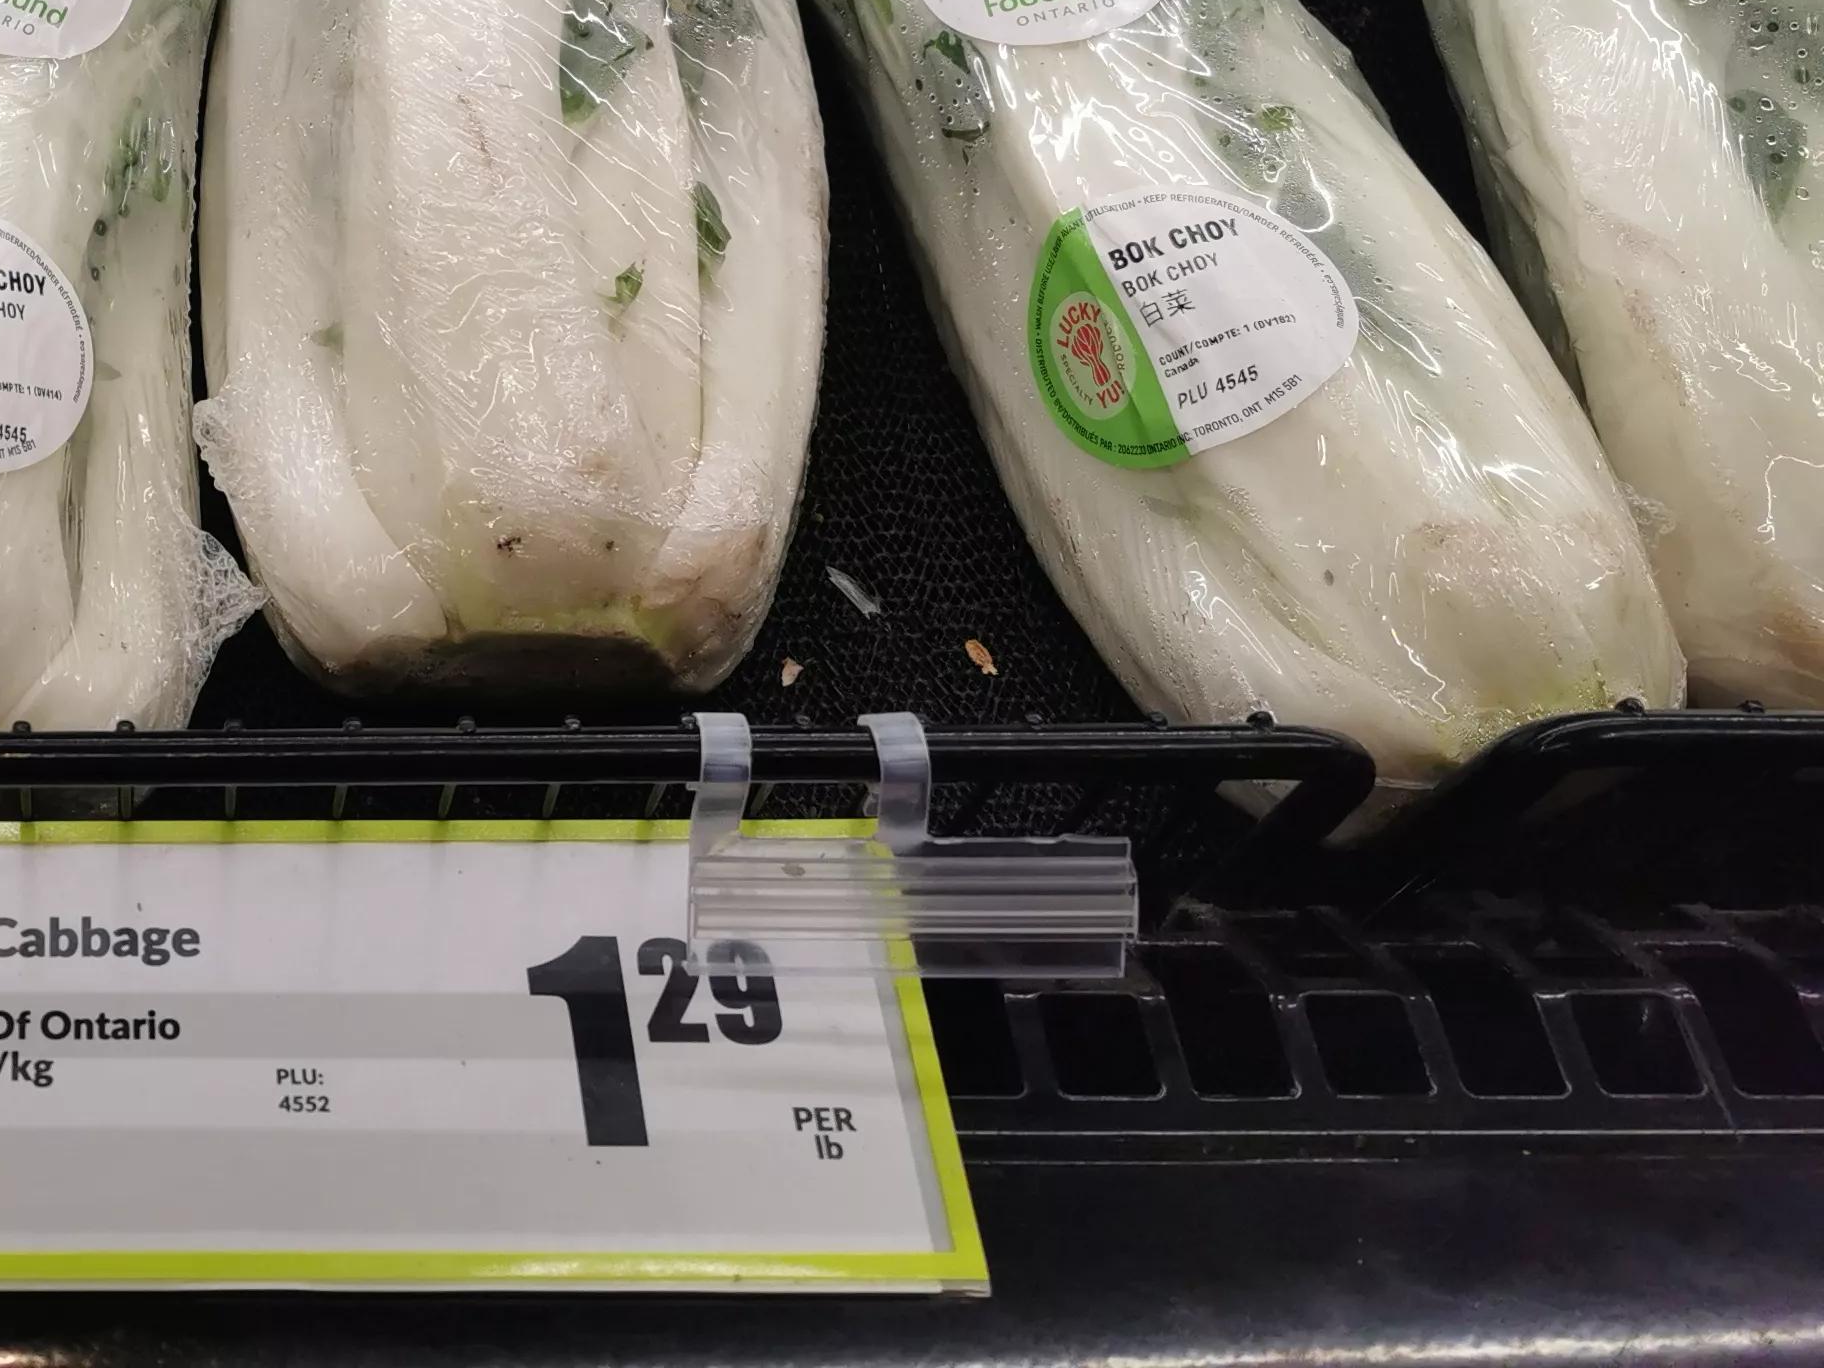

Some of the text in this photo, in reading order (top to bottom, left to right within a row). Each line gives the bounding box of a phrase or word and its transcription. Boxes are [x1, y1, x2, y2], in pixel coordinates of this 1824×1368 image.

[1143, 193, 1167, 205] KEEP
[1108, 217, 1239, 271] BOK CHOY
[1122, 252, 1219, 298] BOK CHOY
[1140, 288, 1196, 327] 白菜
[1057, 301, 1102, 349] LUCKY
[1159, 328, 1241, 366] COUNT/COMPTE:
[1164, 357, 1200, 378] Canada
[1177, 364, 1259, 409] PLU 4545
[1192, 413, 1244, 438] TORONTO,
[1241, 401, 1263, 419] ONT
[1263, 388, 1285, 406] M1S
[1282, 373, 1303, 390] 5B1
[40, 1010, 181, 1040] Ontario
[276, 1069, 325, 1086] PLU:
[278, 1095, 331, 1113] 4552
[792, 1106, 857, 1132] PER
[814, 1134, 844, 1160] lb
